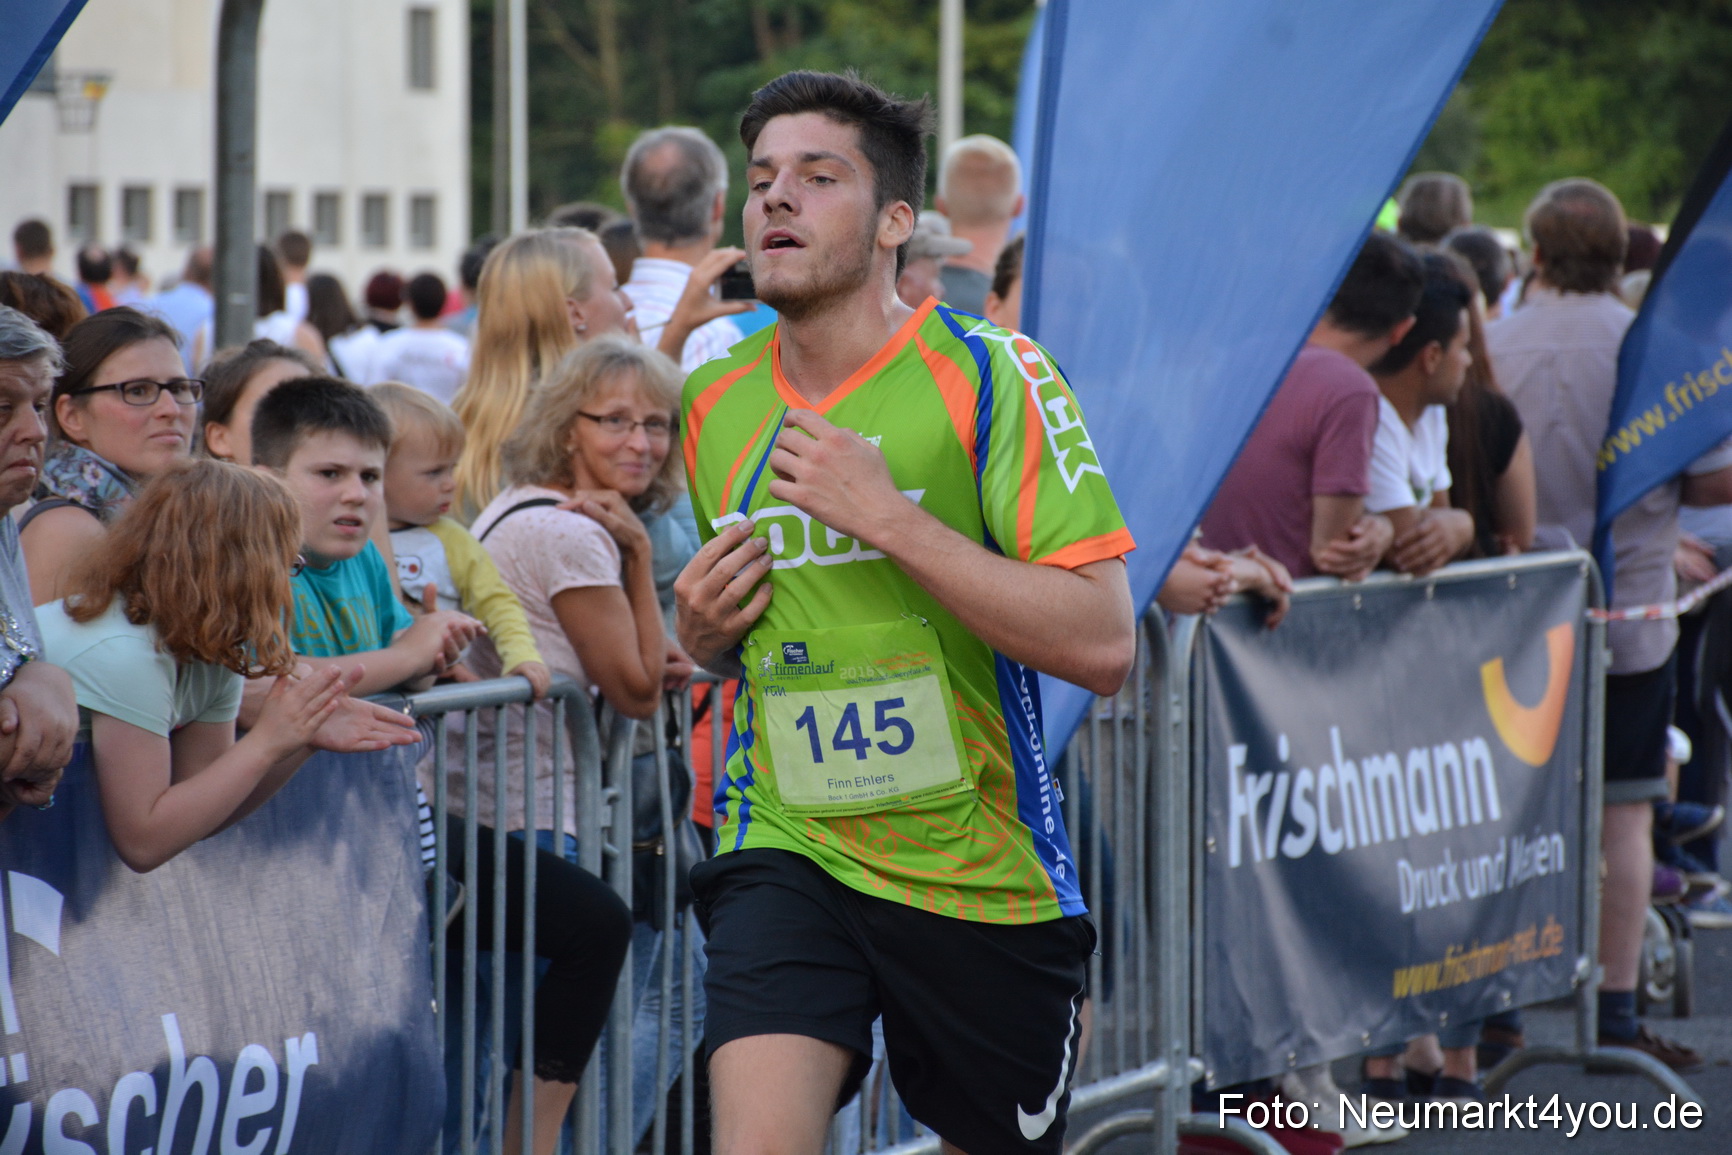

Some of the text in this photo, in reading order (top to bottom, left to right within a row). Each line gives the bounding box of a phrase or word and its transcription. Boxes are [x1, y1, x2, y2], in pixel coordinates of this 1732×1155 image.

[775, 660, 834, 676] firmenlauf
[795, 697, 915, 764] 145
[827, 772, 895, 789] Finn Ehlers
[849, 791, 869, 799] GmbH
[889, 786, 900, 794] KG
[1227, 725, 1500, 868] Frischmann
[1397, 847, 1461, 914] Druck
[1463, 837, 1507, 900] und
